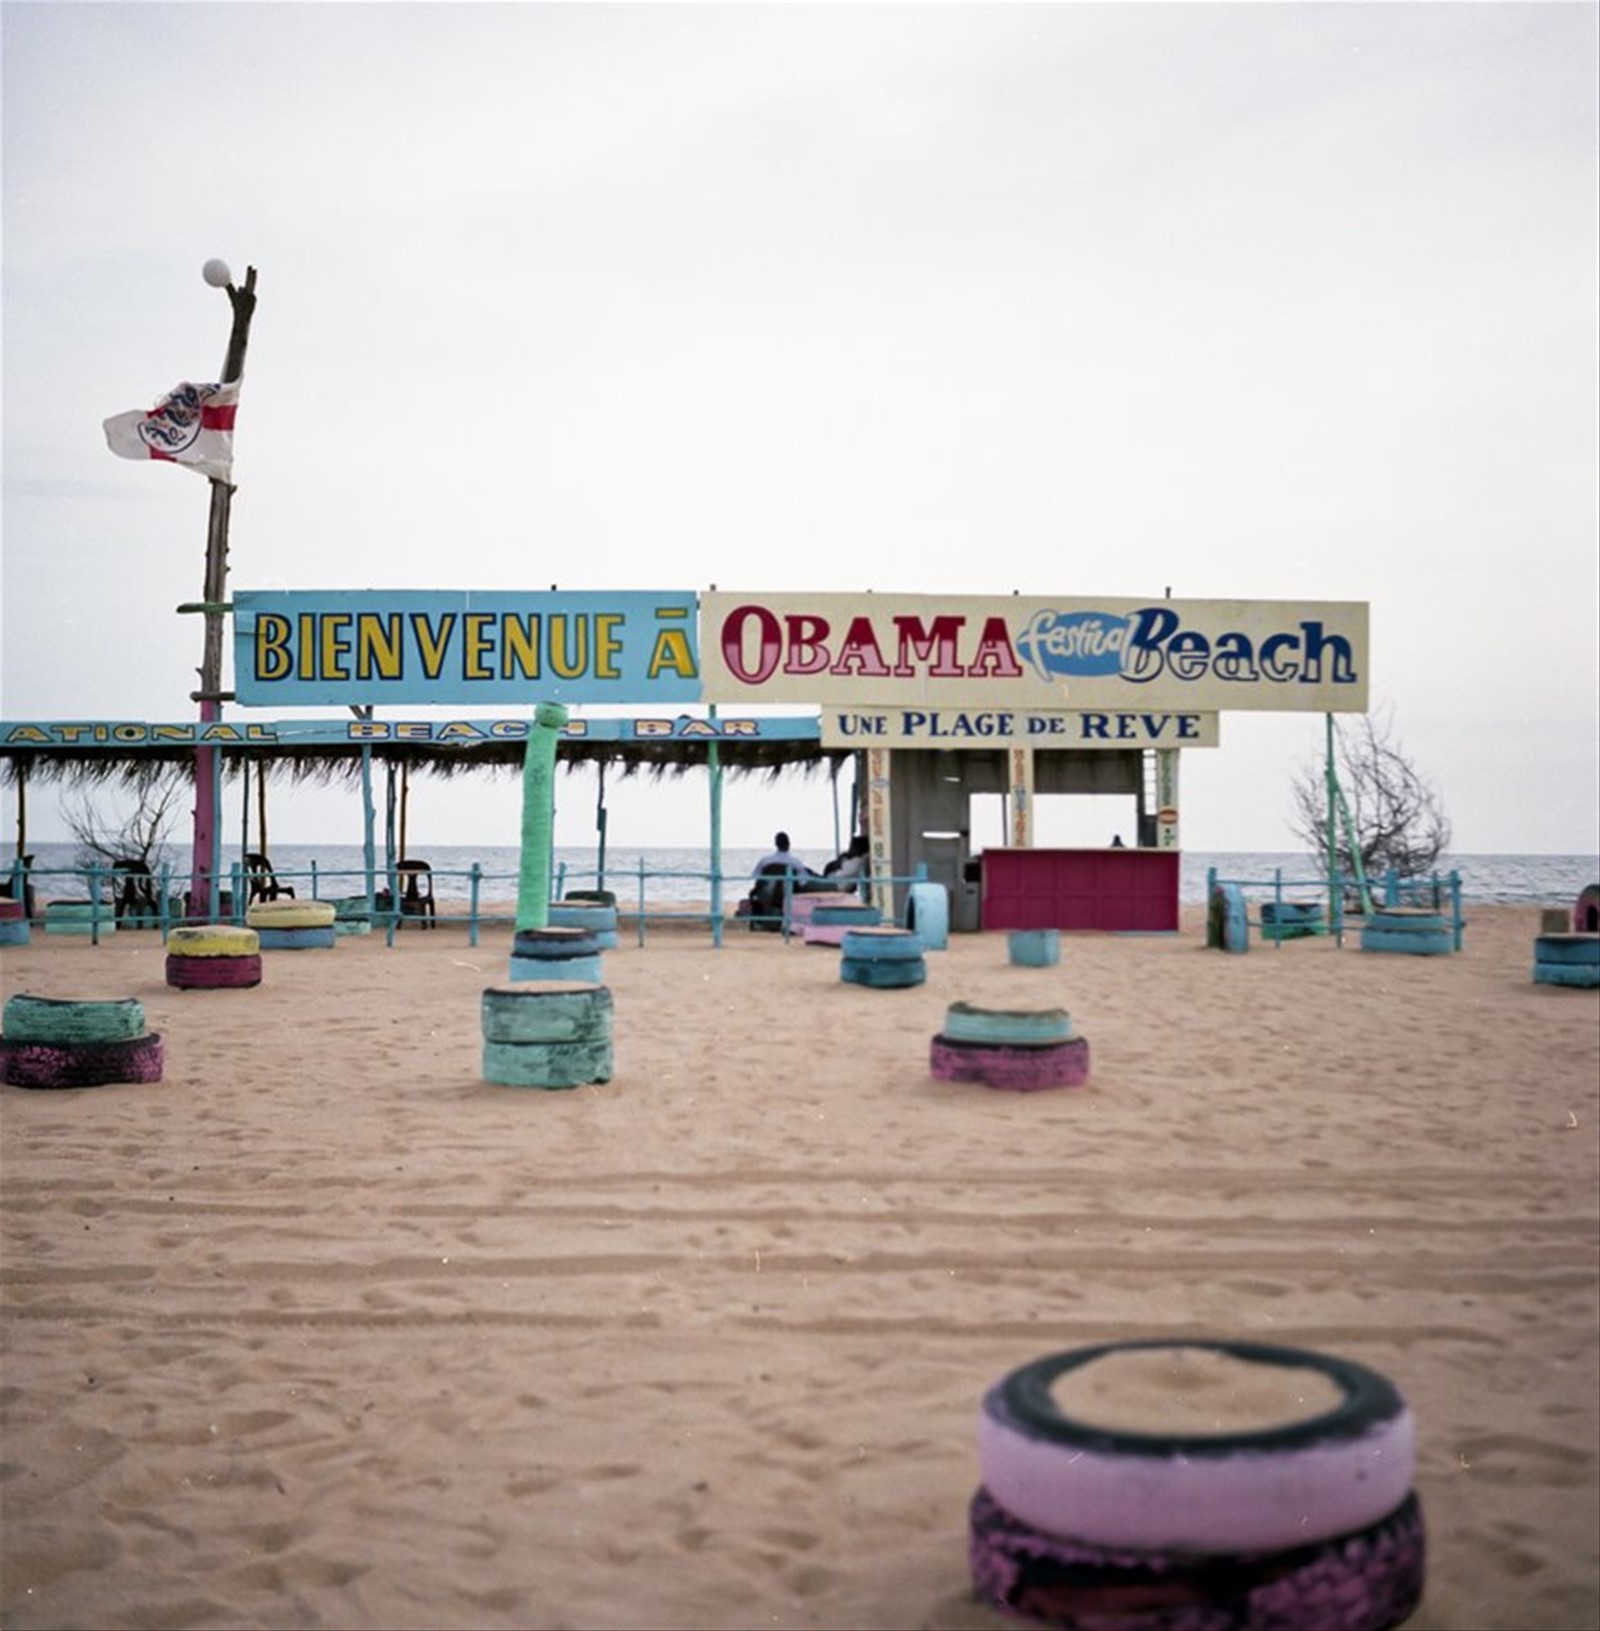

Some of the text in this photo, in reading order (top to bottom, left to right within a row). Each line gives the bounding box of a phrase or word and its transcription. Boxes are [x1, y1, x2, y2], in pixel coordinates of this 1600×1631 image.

[254, 612, 625, 682] BIENVENUE
[721, 605, 1357, 685] OBAMA festival Beach
[634, 718, 761, 738] BAR
[838, 711, 1200, 739] UNE PLAGE DE REVE
